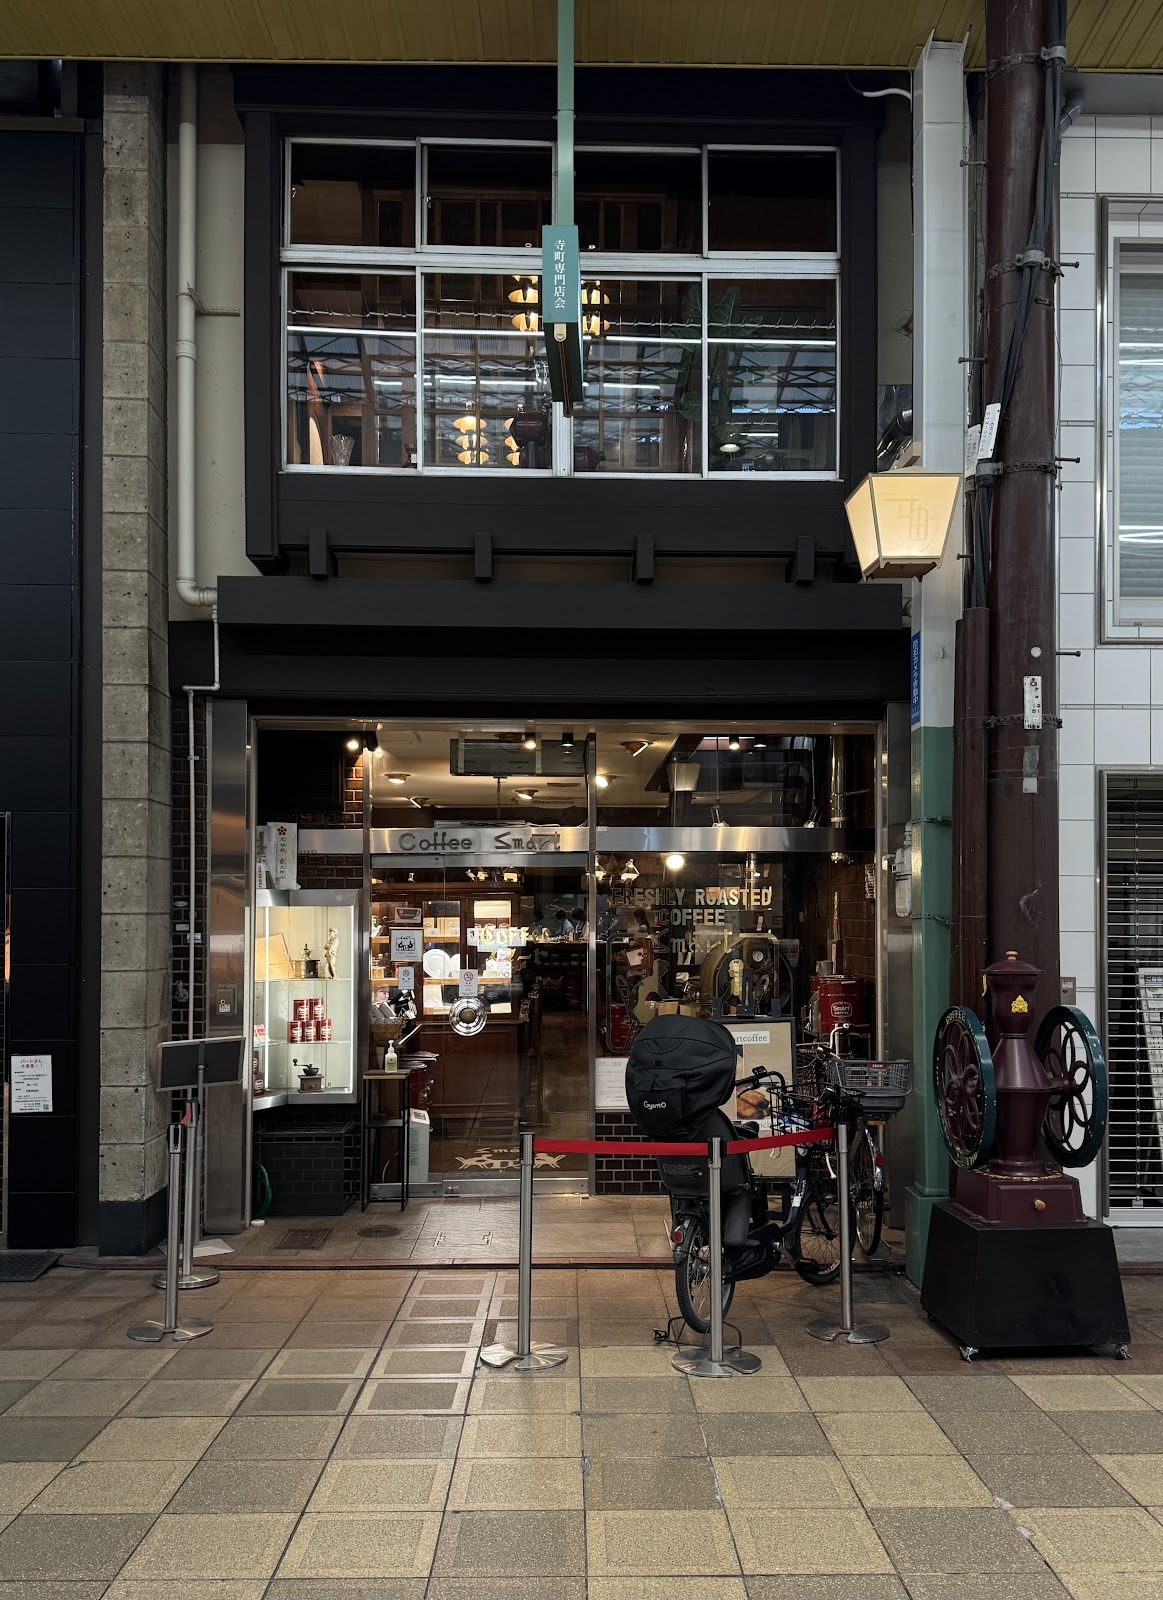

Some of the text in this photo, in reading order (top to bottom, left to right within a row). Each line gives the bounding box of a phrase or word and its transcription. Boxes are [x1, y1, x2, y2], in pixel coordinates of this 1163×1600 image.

[553, 239, 566, 309] 寺町専門店会
[398, 830, 561, 851] Coffee Smart
[610, 887, 772, 906] FRESHLY ROASTED
[658, 908, 725, 926] COFFEE
[832, 1004, 850, 1012] Smart
[945, 1010, 966, 1025] COFFEE
[735, 1033, 768, 1043] rtcoffee
